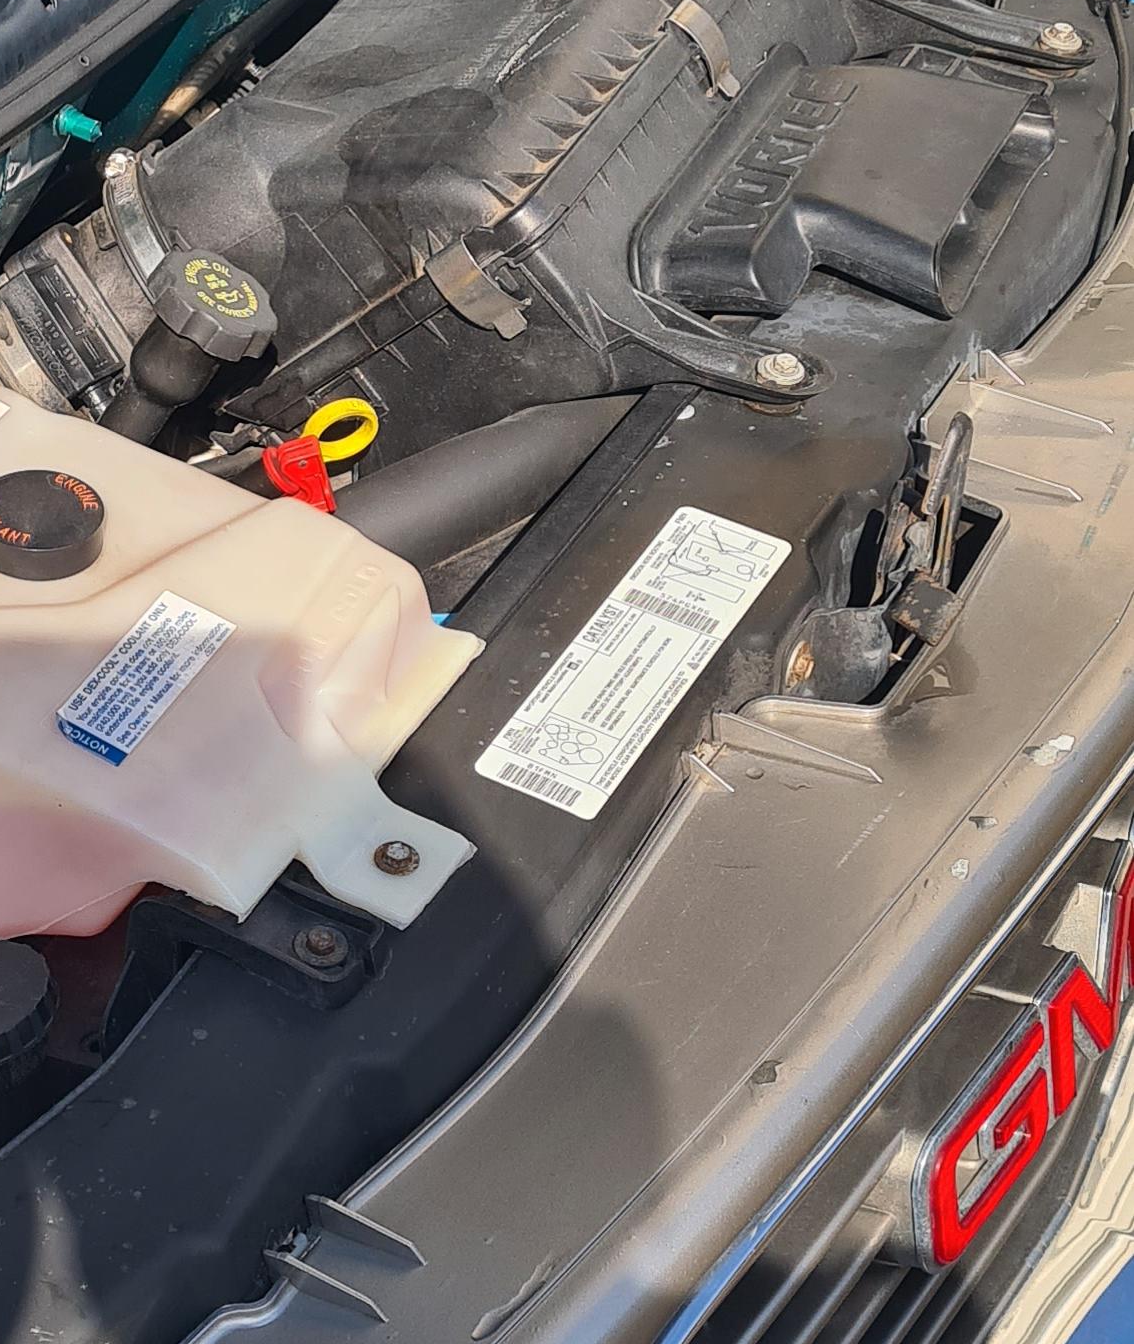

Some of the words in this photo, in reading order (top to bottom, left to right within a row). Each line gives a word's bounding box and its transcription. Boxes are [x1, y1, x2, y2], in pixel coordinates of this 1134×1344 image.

[184, 259, 211, 284] ENGINE
[212, 262, 231, 277] OIL
[55, 473, 99, 511] ENGINE
[580, 603, 620, 643] CATALYST
[68, 692, 87, 712] USE
[118, 620, 153, 656] COOLANT
[148, 602, 170, 623] ONLY
[133, 673, 149, 689] you
[139, 675, 162, 699] engine
[76, 706, 93, 726] Your
[90, 685, 113, 709] engine
[116, 727, 132, 745] See
[150, 680, 175, 706] Manual
[63, 723, 109, 755] NOTICE
